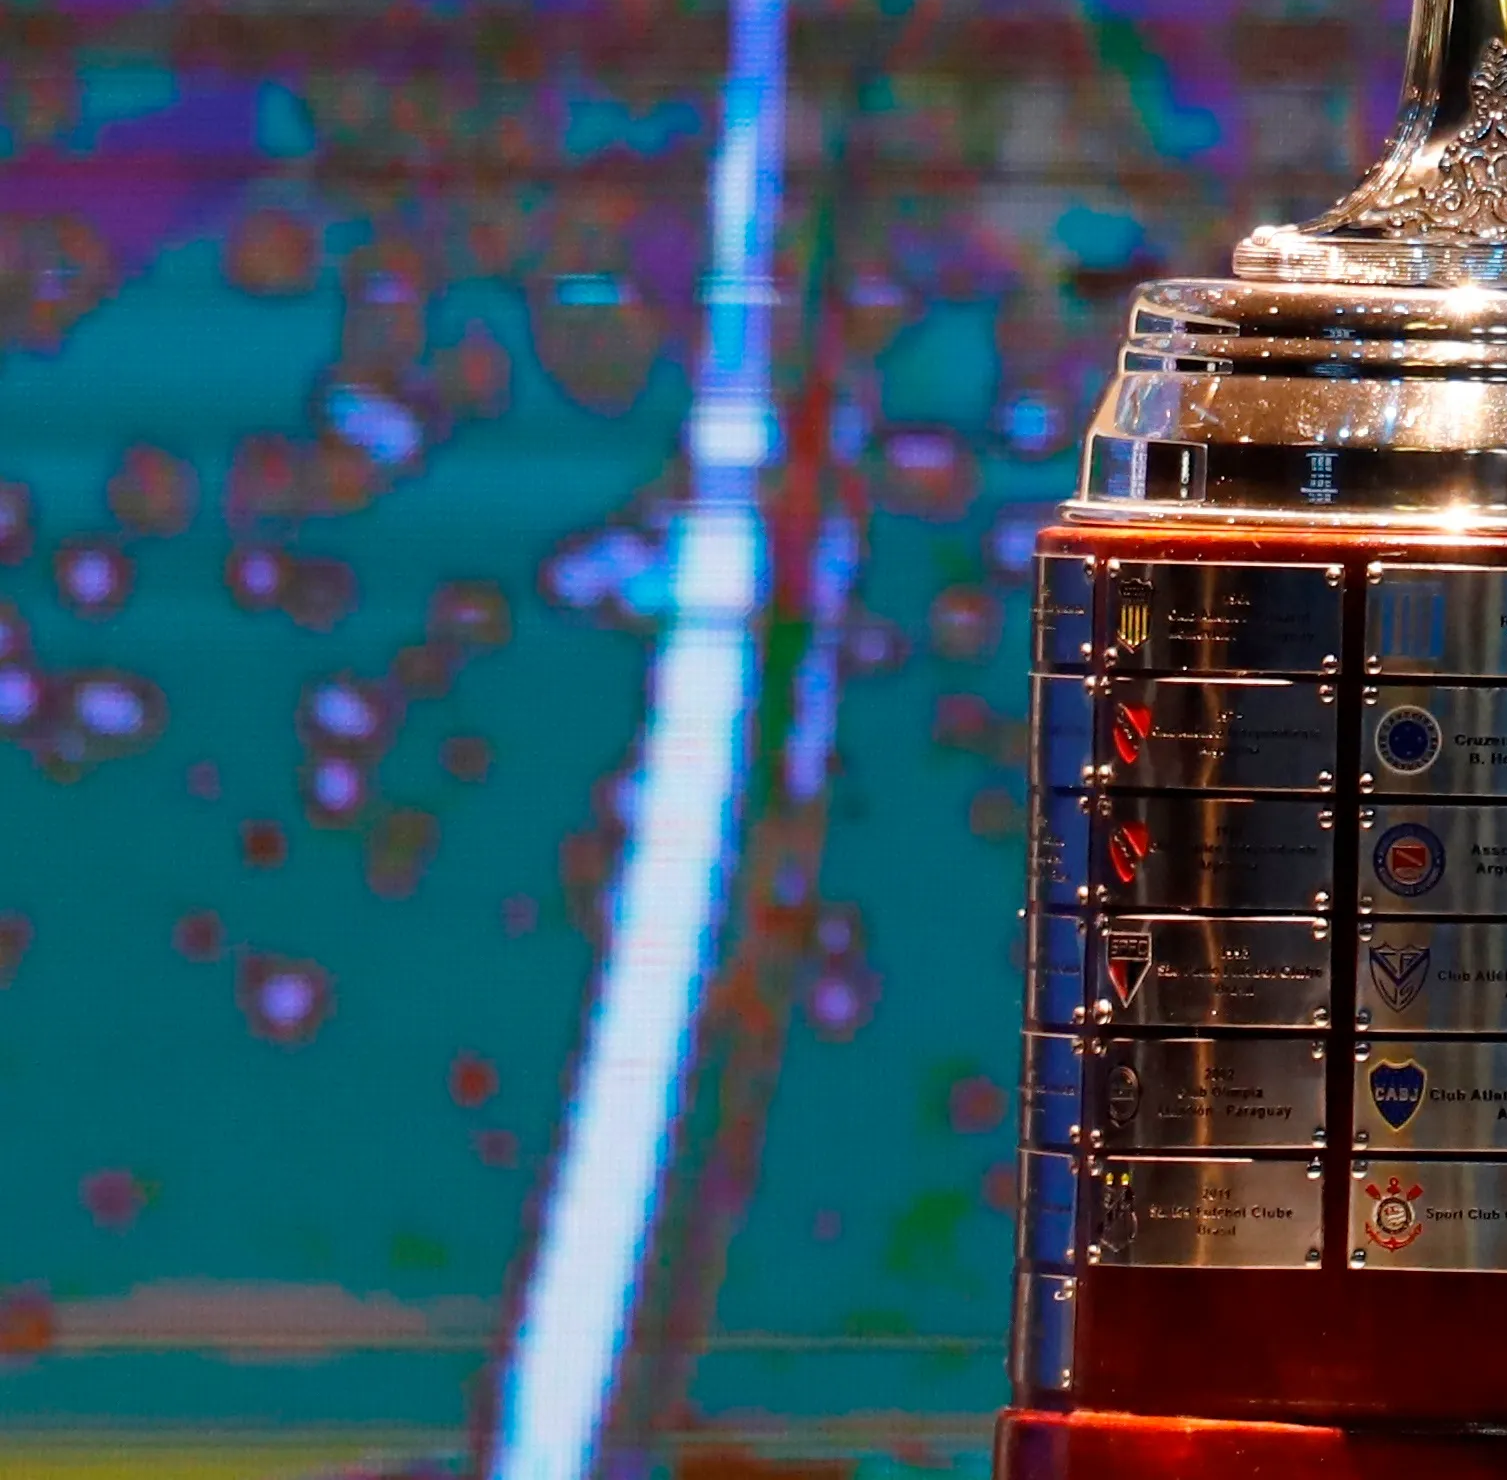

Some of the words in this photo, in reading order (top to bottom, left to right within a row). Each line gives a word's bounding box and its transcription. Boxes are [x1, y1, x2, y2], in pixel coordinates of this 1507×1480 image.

[1375, 1087, 1419, 1101] CABJ
[1429, 1088, 1466, 1101] Club
[1226, 1104, 1293, 1119] Paraguay
[1251, 1204, 1293, 1218] Clube
[1426, 1207, 1463, 1221] Sport
[1467, 1208, 1500, 1220] Club
